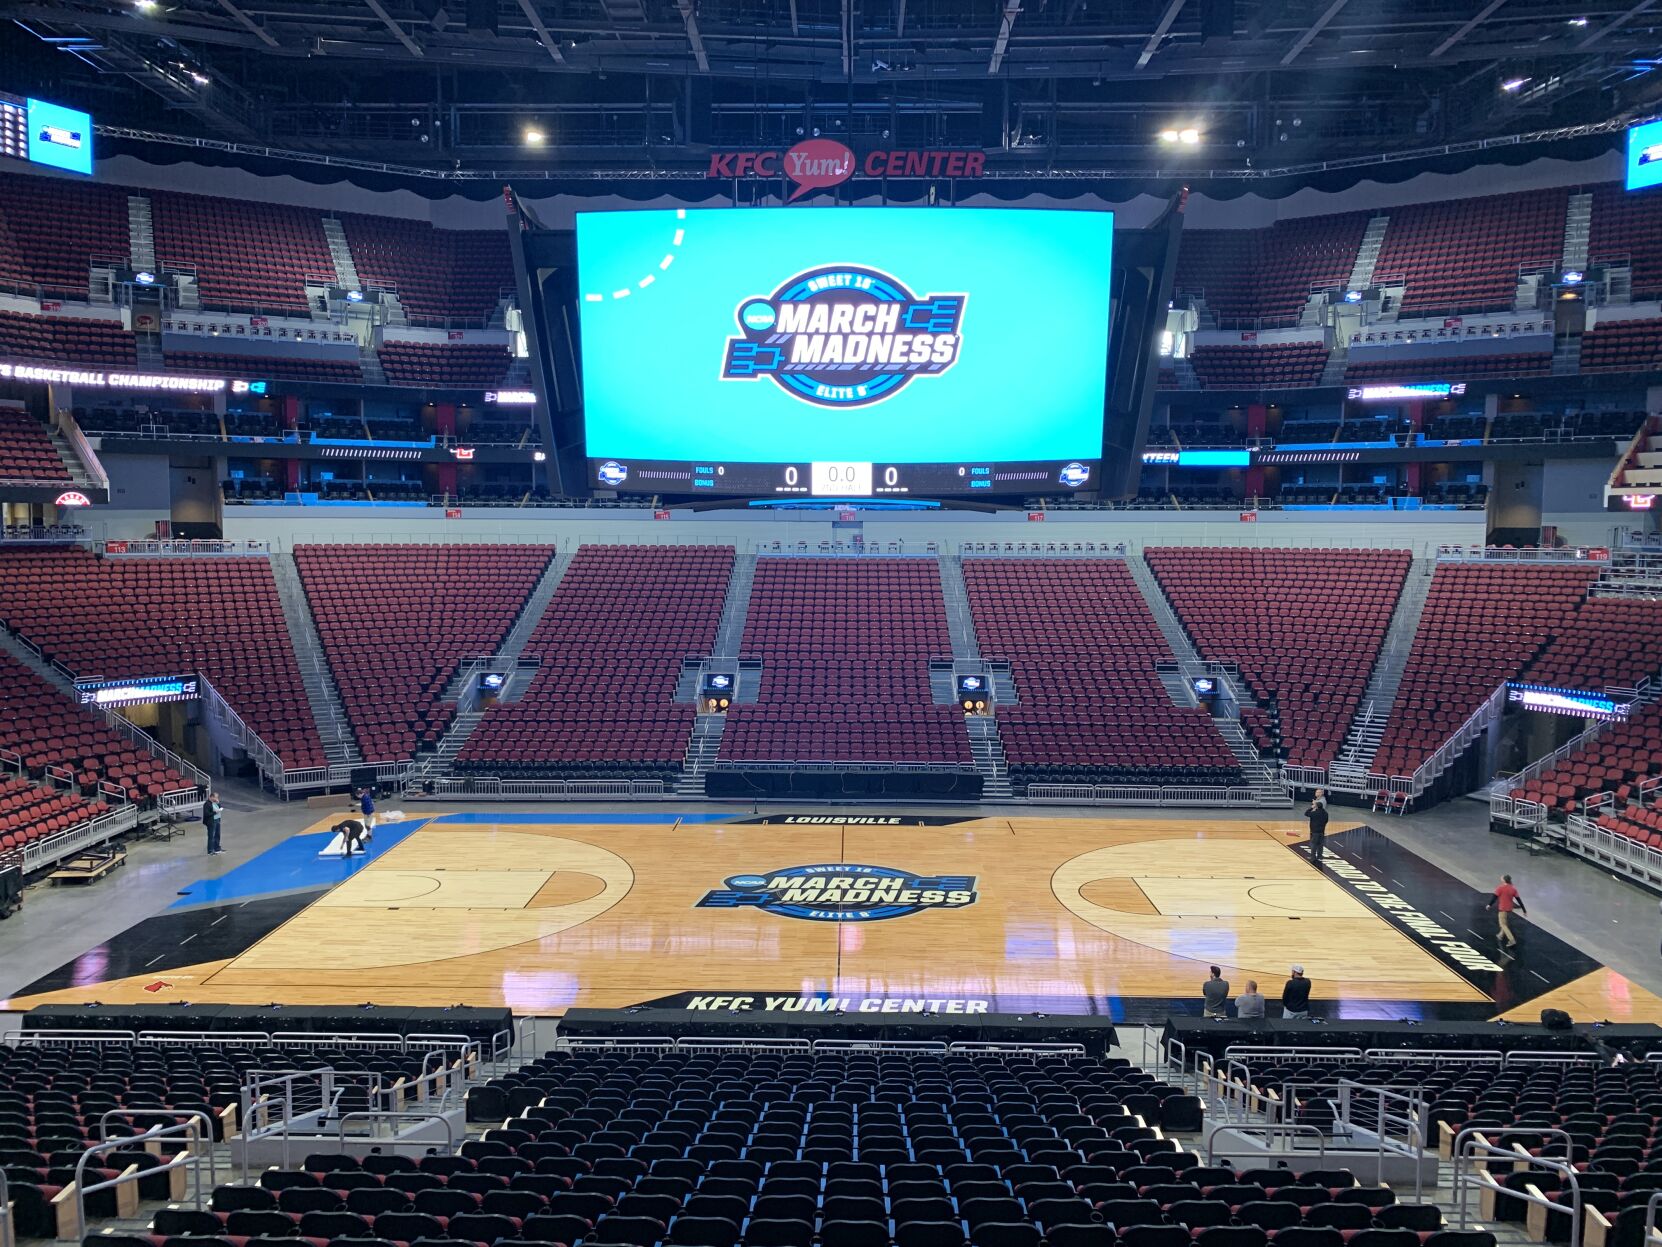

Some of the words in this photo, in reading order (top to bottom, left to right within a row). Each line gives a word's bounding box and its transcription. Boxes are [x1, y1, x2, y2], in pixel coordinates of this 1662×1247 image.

[707, 151, 777, 177] KFC
[790, 151, 850, 176] Yum!
[865, 151, 986, 177] CENTER
[807, 274, 852, 292] SWEET
[776, 303, 900, 333] MARCH
[790, 334, 956, 364] MADNESS
[14, 365, 106, 386] BASKETBALL
[108, 373, 226, 392] CHAMPIONSHIP
[815, 384, 853, 400] ELITE
[695, 466, 714, 474] FOULS
[718, 465, 725, 476] 0
[785, 466, 798, 485] 0
[828, 466, 855, 482] 0.0
[885, 466, 898, 486] 0
[958, 466, 966, 476] 0
[971, 467, 990, 475] FOULS
[784, 816, 902, 825] LOUISVILLE
[805, 866, 852, 874] SWEET
[1318, 858, 1370, 880] ROAD
[733, 879, 766, 887] NCAA
[766, 876, 905, 889] MARCH
[1348, 880, 1389, 892] TO
[780, 888, 973, 902] MADNESS
[1365, 893, 1416, 912] THE
[808, 910, 853, 919] ELITE
[1389, 911, 1456, 938] FINAL
[1430, 940, 1504, 972] FOUR
[686, 996, 755, 1011] KFC
[764, 997, 850, 1012] YUM!
[858, 998, 989, 1014] CENTER
